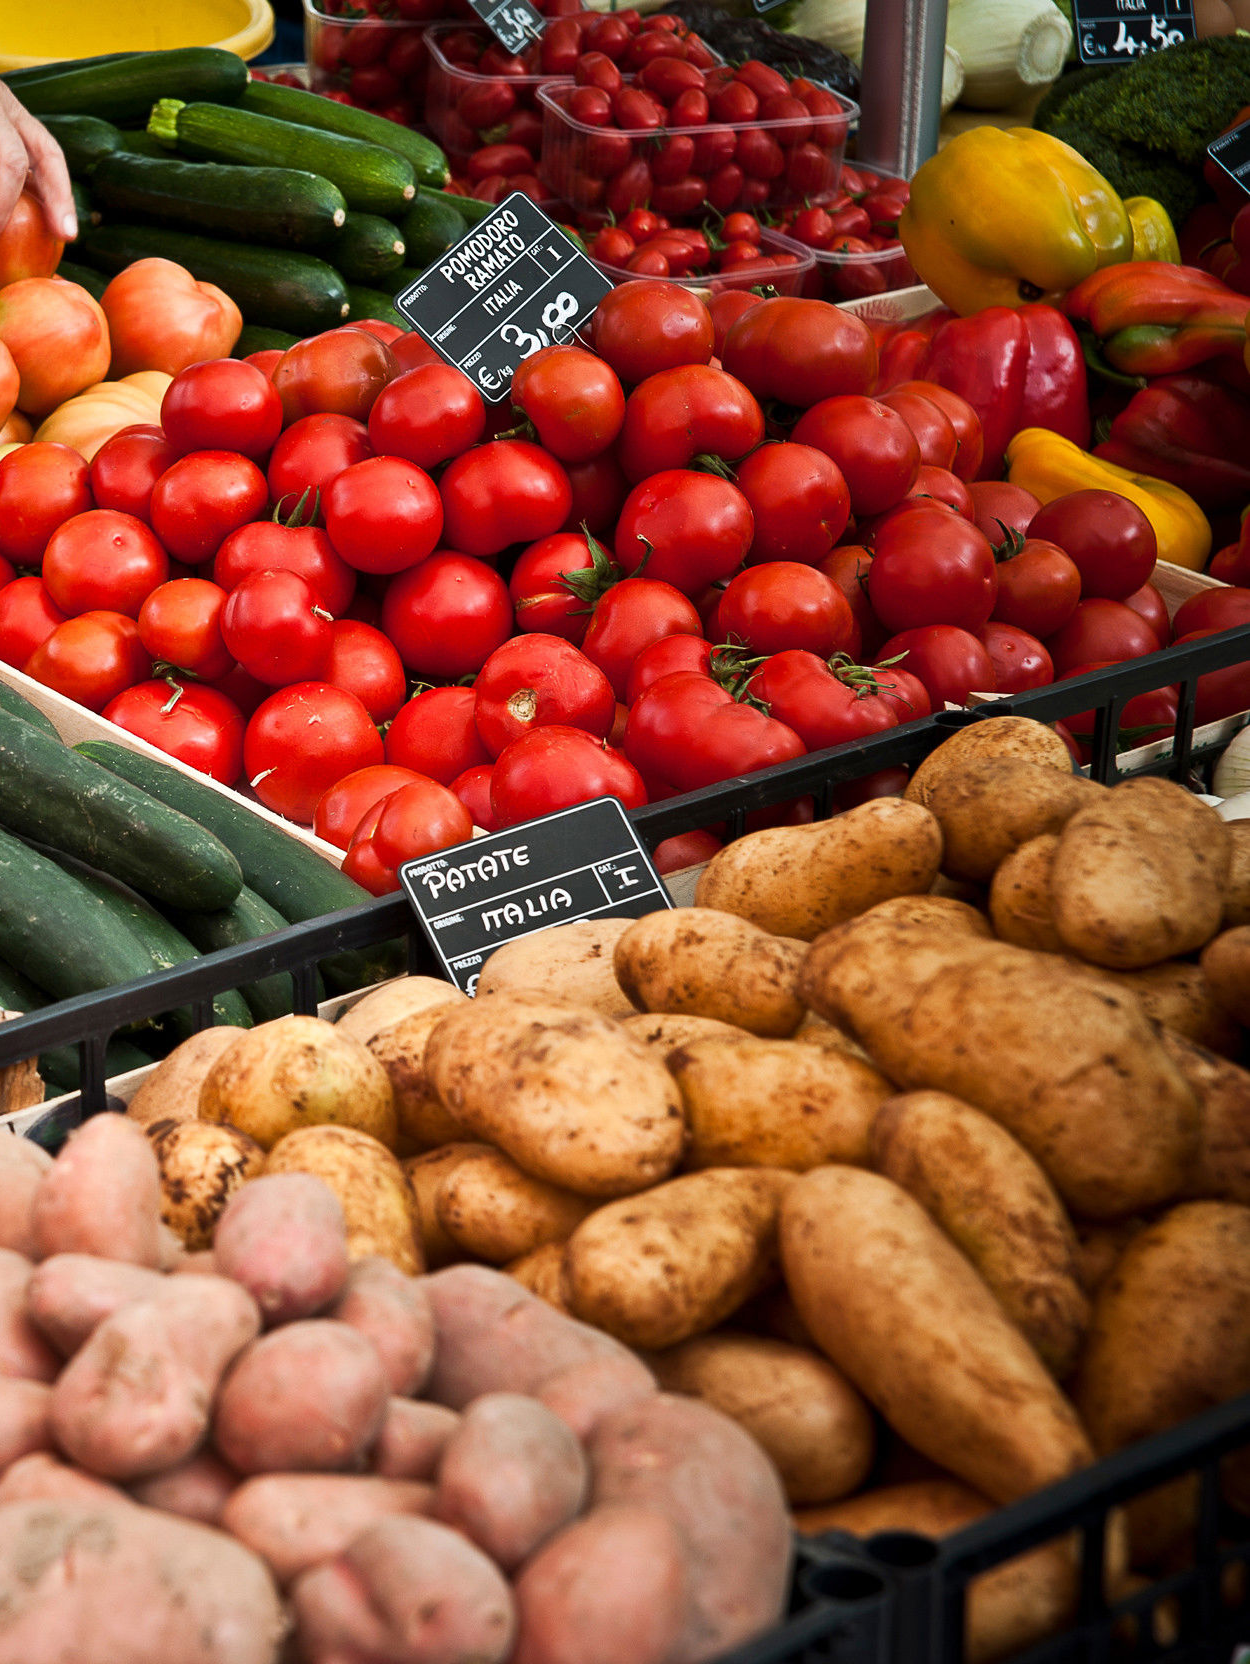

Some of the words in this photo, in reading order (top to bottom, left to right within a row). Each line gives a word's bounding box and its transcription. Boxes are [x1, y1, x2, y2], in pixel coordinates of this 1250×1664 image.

[439, 209, 519, 284] POMODORO
[546, 246, 563, 262] I
[464, 233, 526, 291] RAMATO
[402, 284, 428, 308] PRODOTTO:
[482, 280, 524, 316] ITALIA
[436, 324, 458, 342] ORIGINE:
[462, 352, 482, 370] PREZZO
[478, 365, 514, 390] €/kg
[407, 858, 449, 878] PRODOTTO:
[422, 845, 530, 900] PATATE
[433, 913, 465, 930] ORIGINE:
[481, 888, 573, 931] ITALIA
[452, 954, 482, 971] PREZZO
